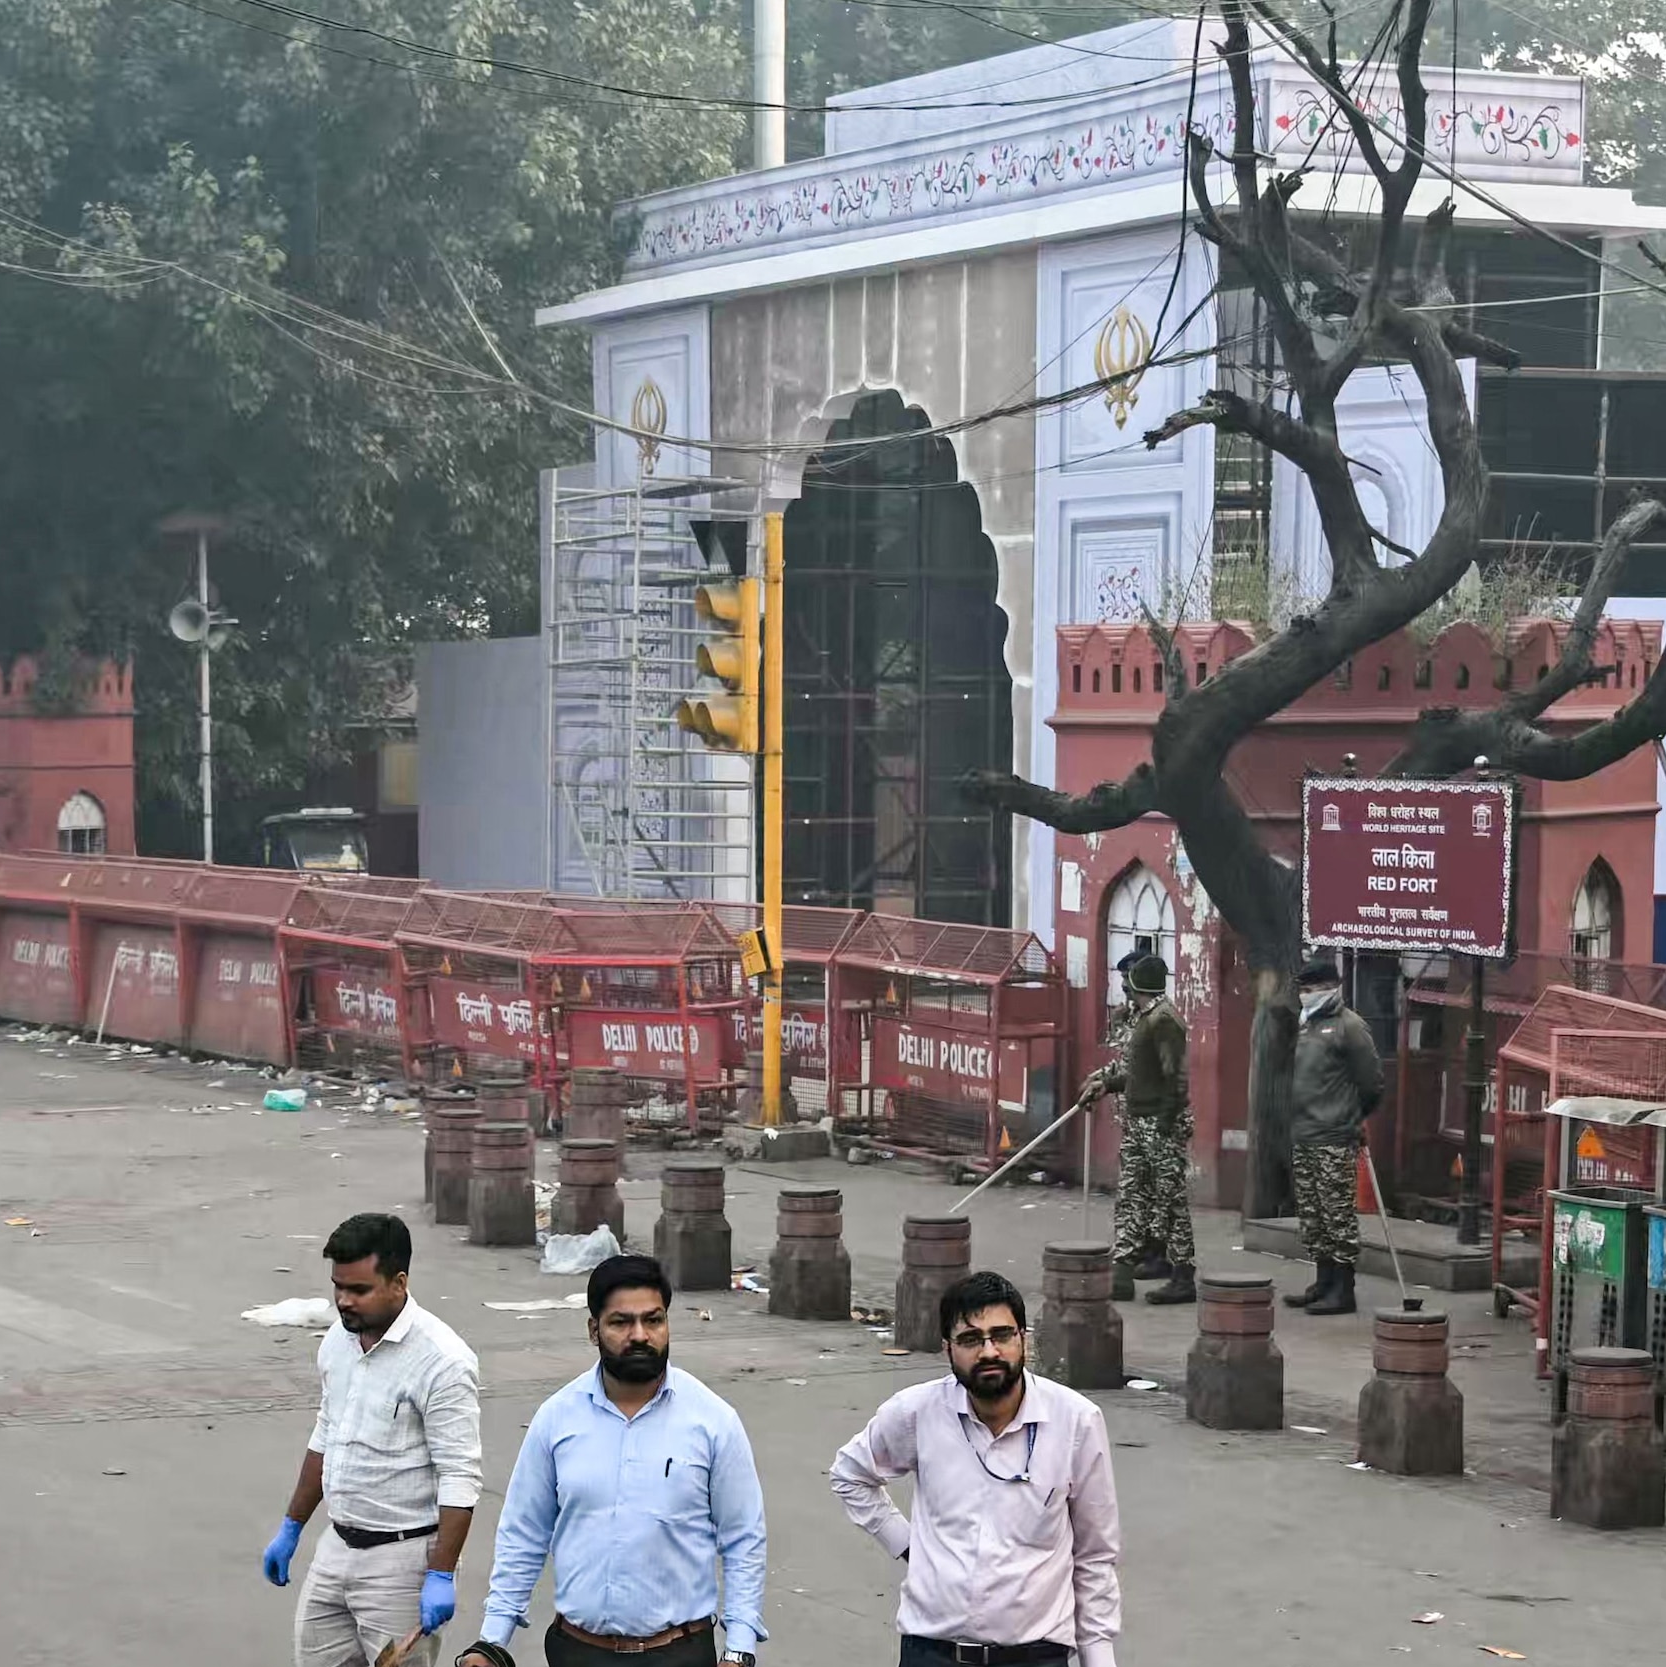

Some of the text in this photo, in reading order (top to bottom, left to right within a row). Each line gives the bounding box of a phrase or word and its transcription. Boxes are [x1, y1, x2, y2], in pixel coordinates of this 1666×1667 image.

[1368, 802, 1439, 819] विश्व धरोहर स्थल
[1362, 824, 1445, 835] WORLD HERITAGE SITE
[1371, 843, 1435, 869] लाल किला
[1367, 876, 1438, 893] RED FORT
[1358, 903, 1386, 918] भारतीय
[1389, 907, 1417, 922] पुरातत्व
[1331, 923, 1476, 940] ARCHAEOLOGICAL SURVEY OF INDIA
[456, 992, 493, 1027] दिल्ली
[601, 1023, 685, 1053] DELHI POLICE
[898, 1032, 987, 1079] DELHI POLICE
